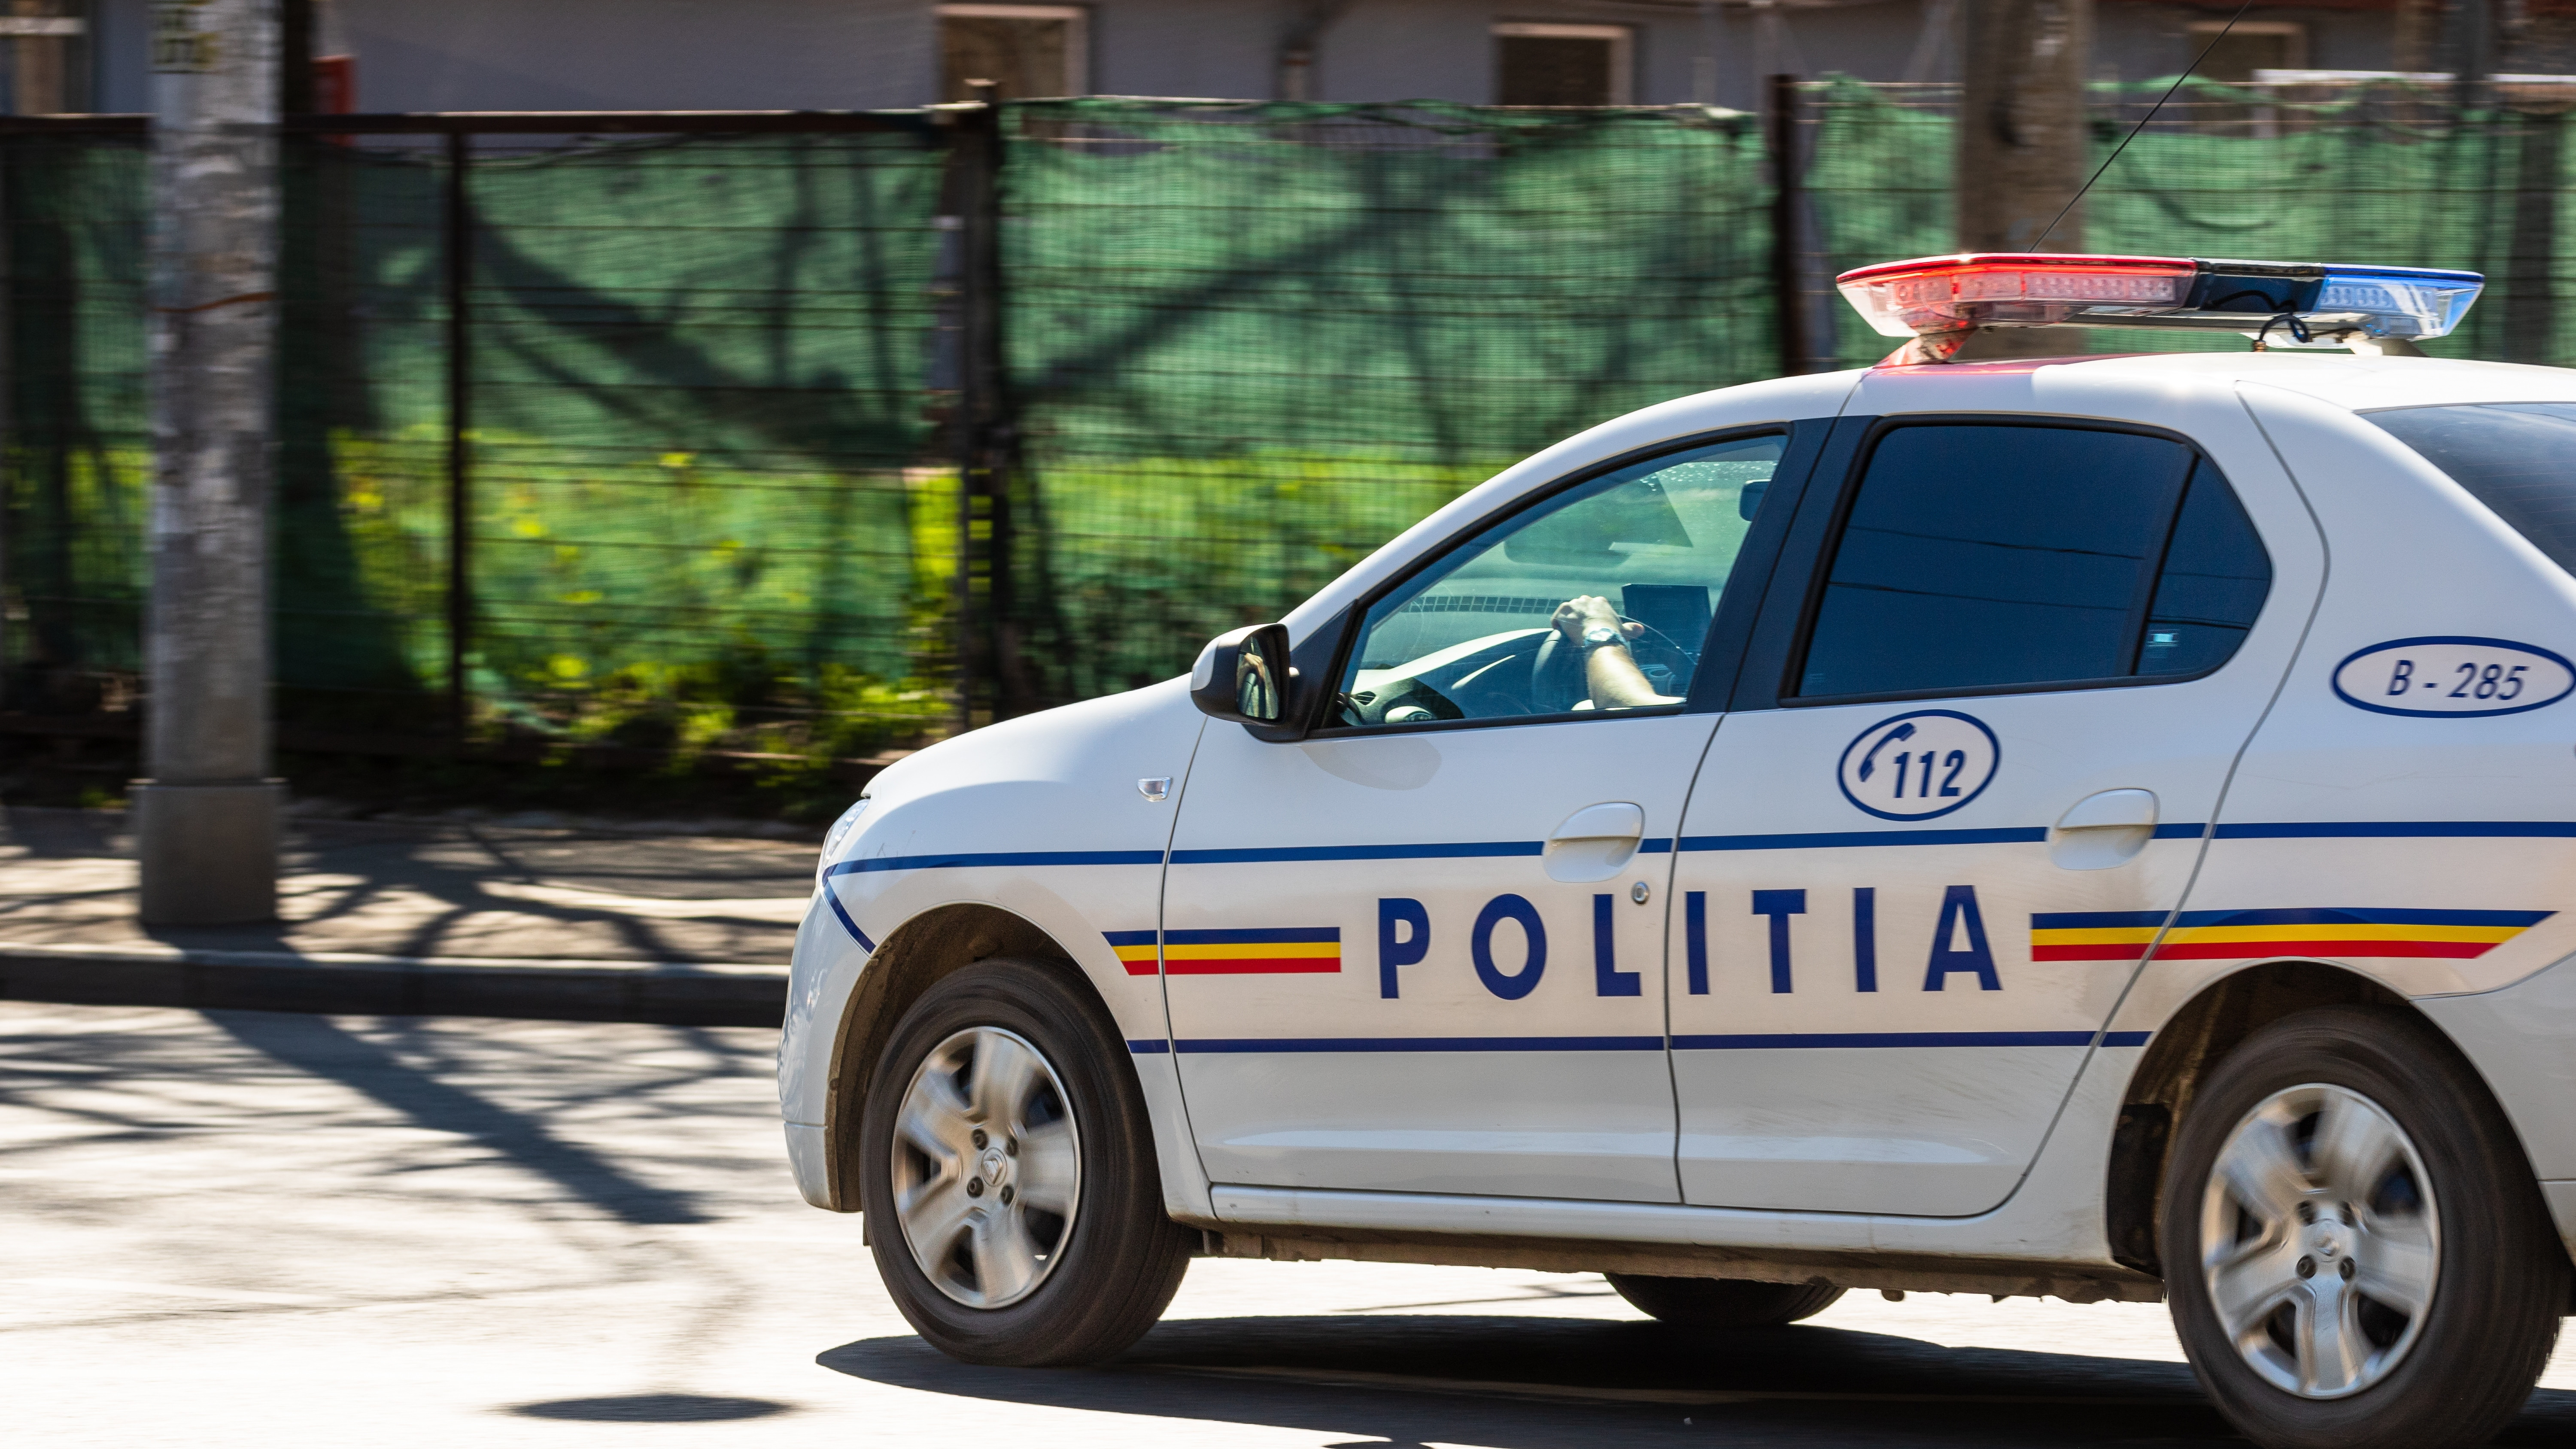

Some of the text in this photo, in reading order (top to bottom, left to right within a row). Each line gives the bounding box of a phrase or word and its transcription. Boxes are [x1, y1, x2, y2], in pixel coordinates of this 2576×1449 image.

[2385, 659, 2415, 696] B
[2446, 662, 2530, 701] 285
[1893, 749, 1967, 799] 112
[1377, 884, 2004, 1001] POLITIA
